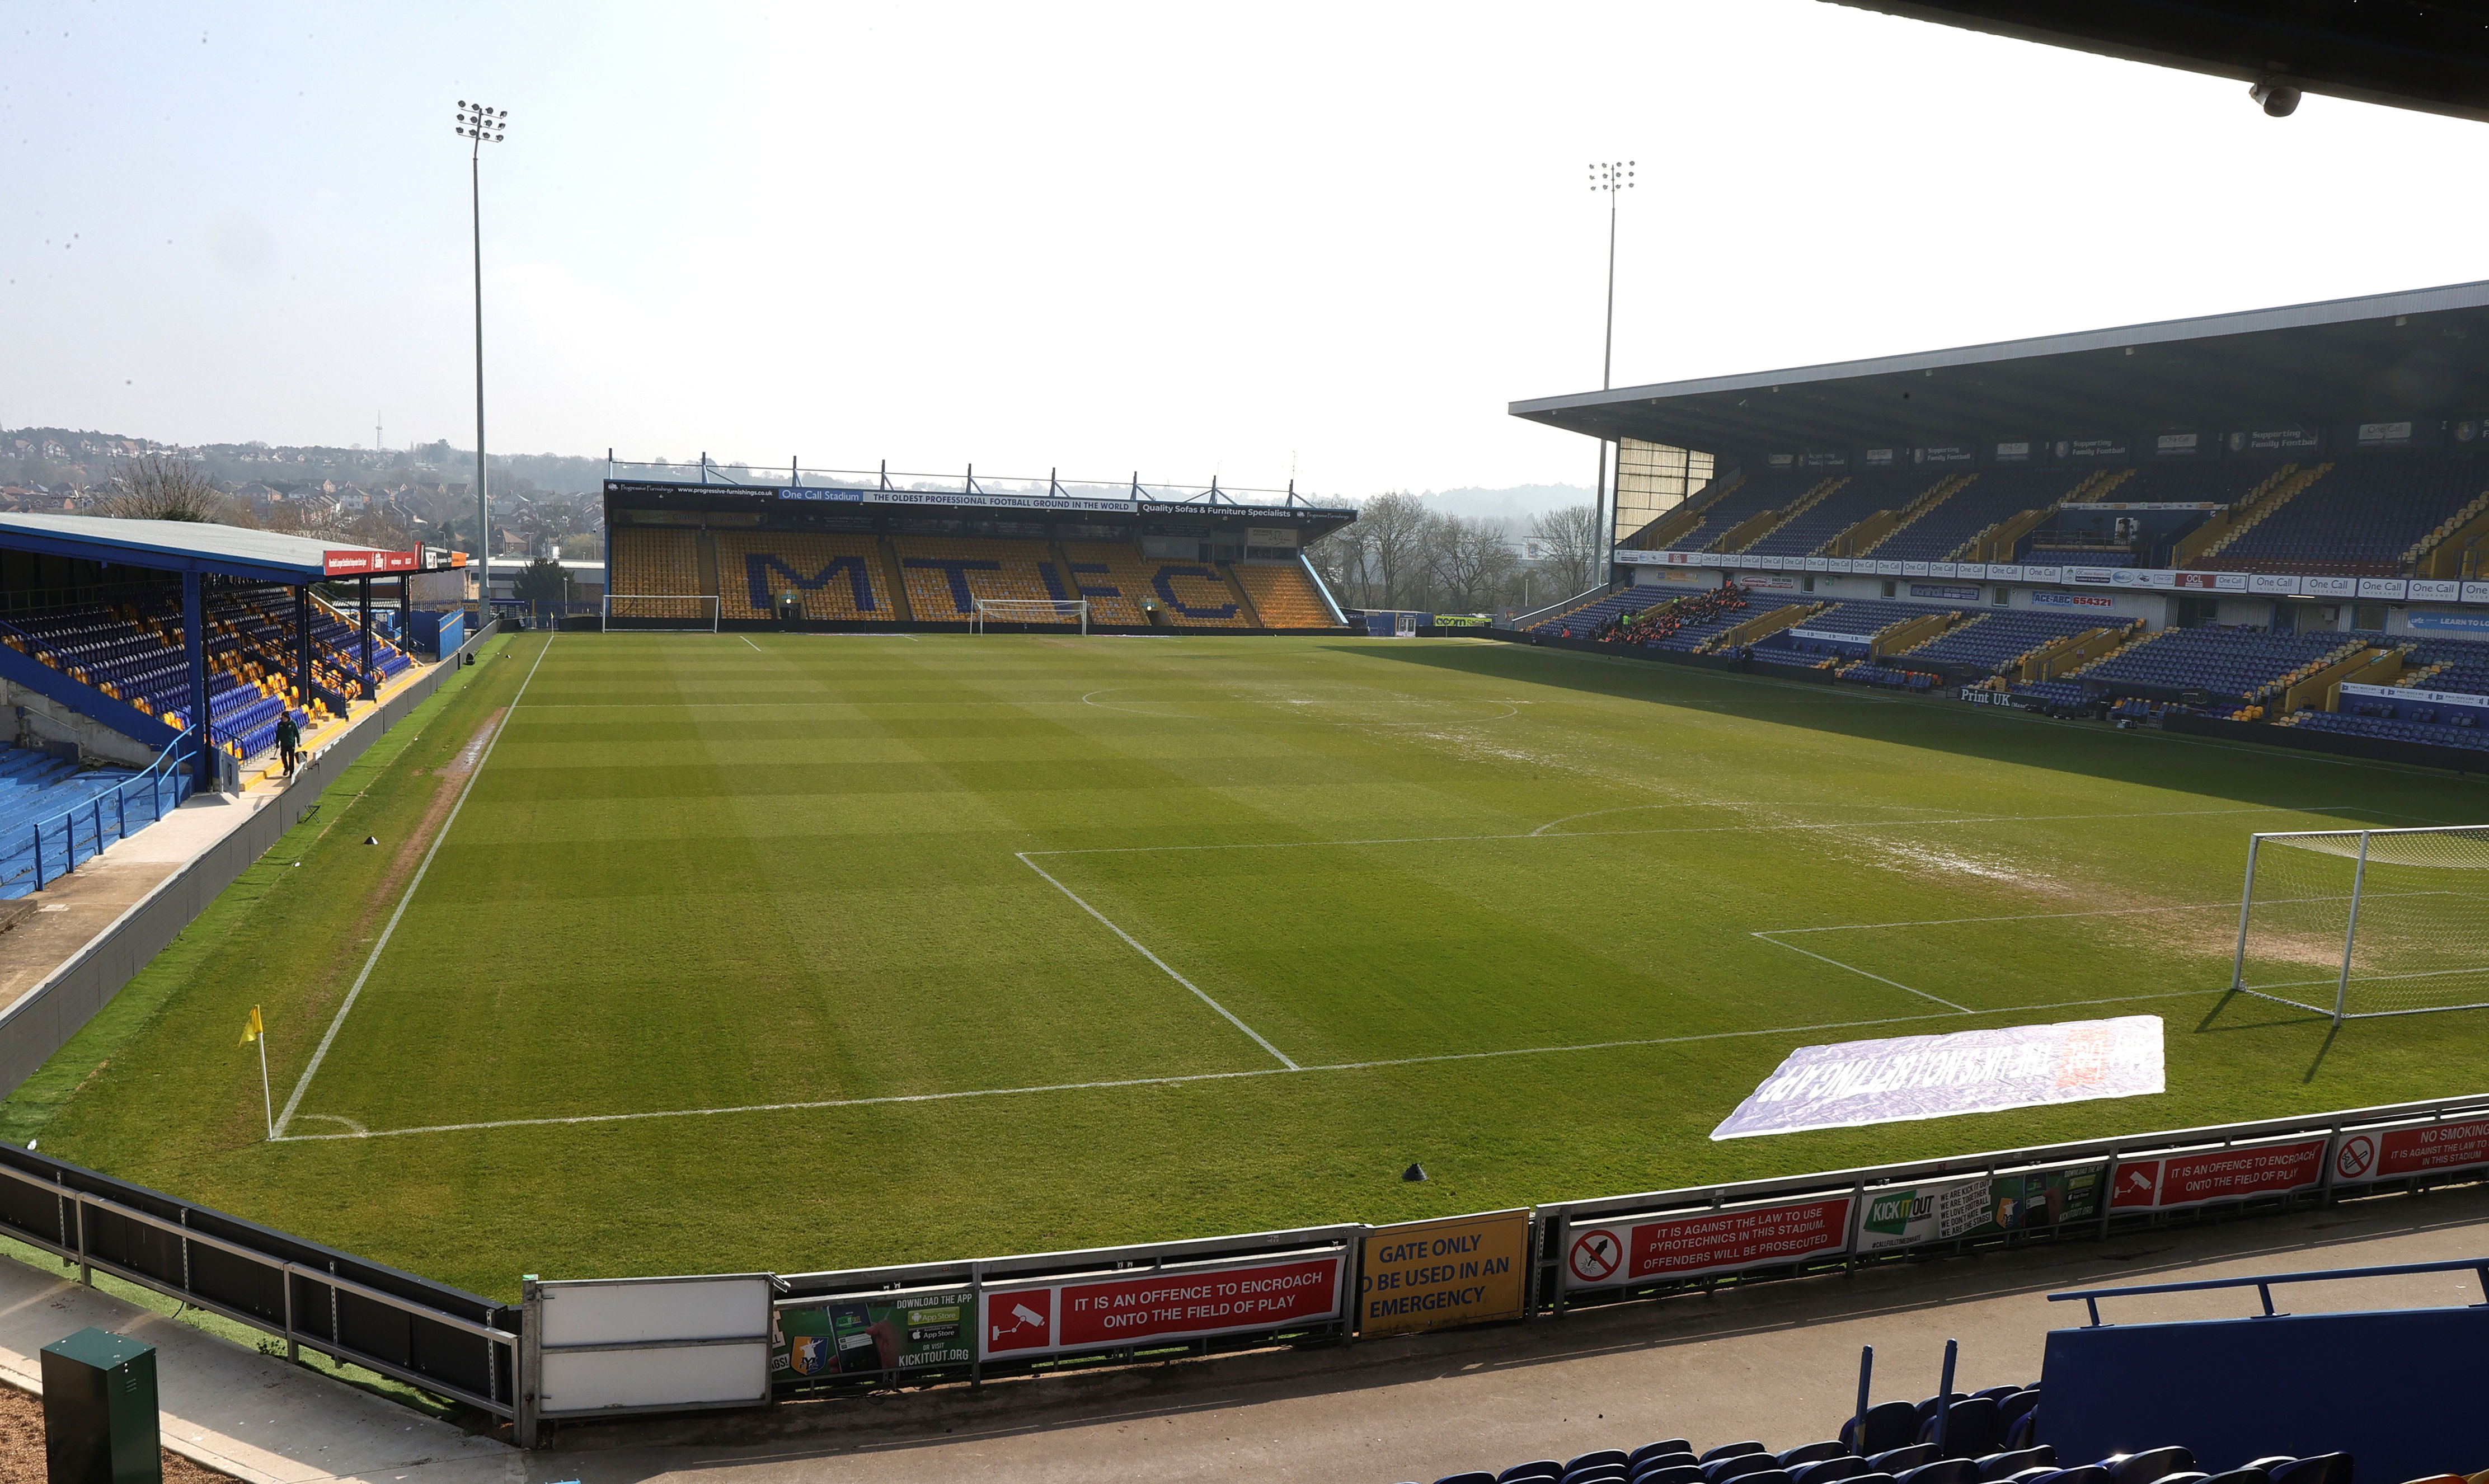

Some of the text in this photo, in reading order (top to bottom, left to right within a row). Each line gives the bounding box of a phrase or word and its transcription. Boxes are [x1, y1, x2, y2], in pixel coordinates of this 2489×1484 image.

[678, 487, 772, 496] www.progressive-furnishings.co.uk
[782, 489, 859, 501] One Call Stadium
[892, 494, 922, 503] OLDEST
[926, 496, 987, 505] PROFESSIONAL
[990, 497, 1031, 506] FOOTBALL
[1034, 500, 1069, 508] GROUND
[1143, 504, 1173, 514] Quality
[1175, 505, 1197, 514] Sofas
[1208, 507, 1246, 516] Furniture
[1248, 508, 1290, 518] Specialists
[2186, 574, 2203, 583] OCL
[2257, 577, 2292, 586] One Call
[2310, 579, 2348, 589] One Call
[2363, 581, 2401, 591] One Call
[2413, 583, 2454, 593] One Call
[2466, 585, 2487, 594] One
[2035, 594, 2111, 606] ACE-ABC 654321
[1961, 689, 2012, 707] Print UK
[2421, 1130, 2437, 1143] NO
[2391, 1139, 2486, 1159] IT IS AGAINST THE LAW TO
[2422, 1150, 2482, 1166] IN THIS STADIUM
[2171, 1150, 2316, 1178] IT IS AN OFFENCE TO ENCROACH
[2186, 1167, 2299, 1191] ONTO THE FIELD OF PLAY
[1940, 1179, 1990, 1201] WE ARE KICK IT OUT
[1940, 1189, 1986, 1210] WE ARE TOGETHER
[1873, 1200, 1900, 1222] KICK
[1900, 1199, 1912, 1218] IT
[1912, 1195, 1934, 1215] OUT
[1940, 1196, 1988, 1219] WE LOVE FOOTBALL
[1657, 1208, 1823, 1238] IT IS AGAINST THE LAW TO USE
[1941, 1220, 1950, 1228] WE
[1951, 1214, 1966, 1225] DON'T
[1967, 1209, 1979, 1220] HATE
[1941, 1213, 1990, 1237] WE ARE THE STAGS!
[1650, 1220, 1825, 1252] PYROTECHNICS IN THIS STADIUM.
[1379, 1234, 1482, 1263] GATE ONLY
[1643, 1234, 1828, 1269] OFFENDERS WILL BE PROSECUTED
[1378, 1271, 1401, 1290] BE
[1405, 1265, 1455, 1286] USED
[1459, 1261, 1478, 1279] IN
[1483, 1257, 1509, 1275] AN
[1074, 1272, 1322, 1311] IT IS AN OFFENCE TO ENCROACH
[897, 1294, 972, 1309] DOWNLOAD THE APP
[1103, 1294, 1296, 1328] ONTO THE FIELD OF PLAY
[1370, 1286, 1486, 1318] EMERGENCY
[899, 1349, 969, 1367] KICKITOUT.ORG
